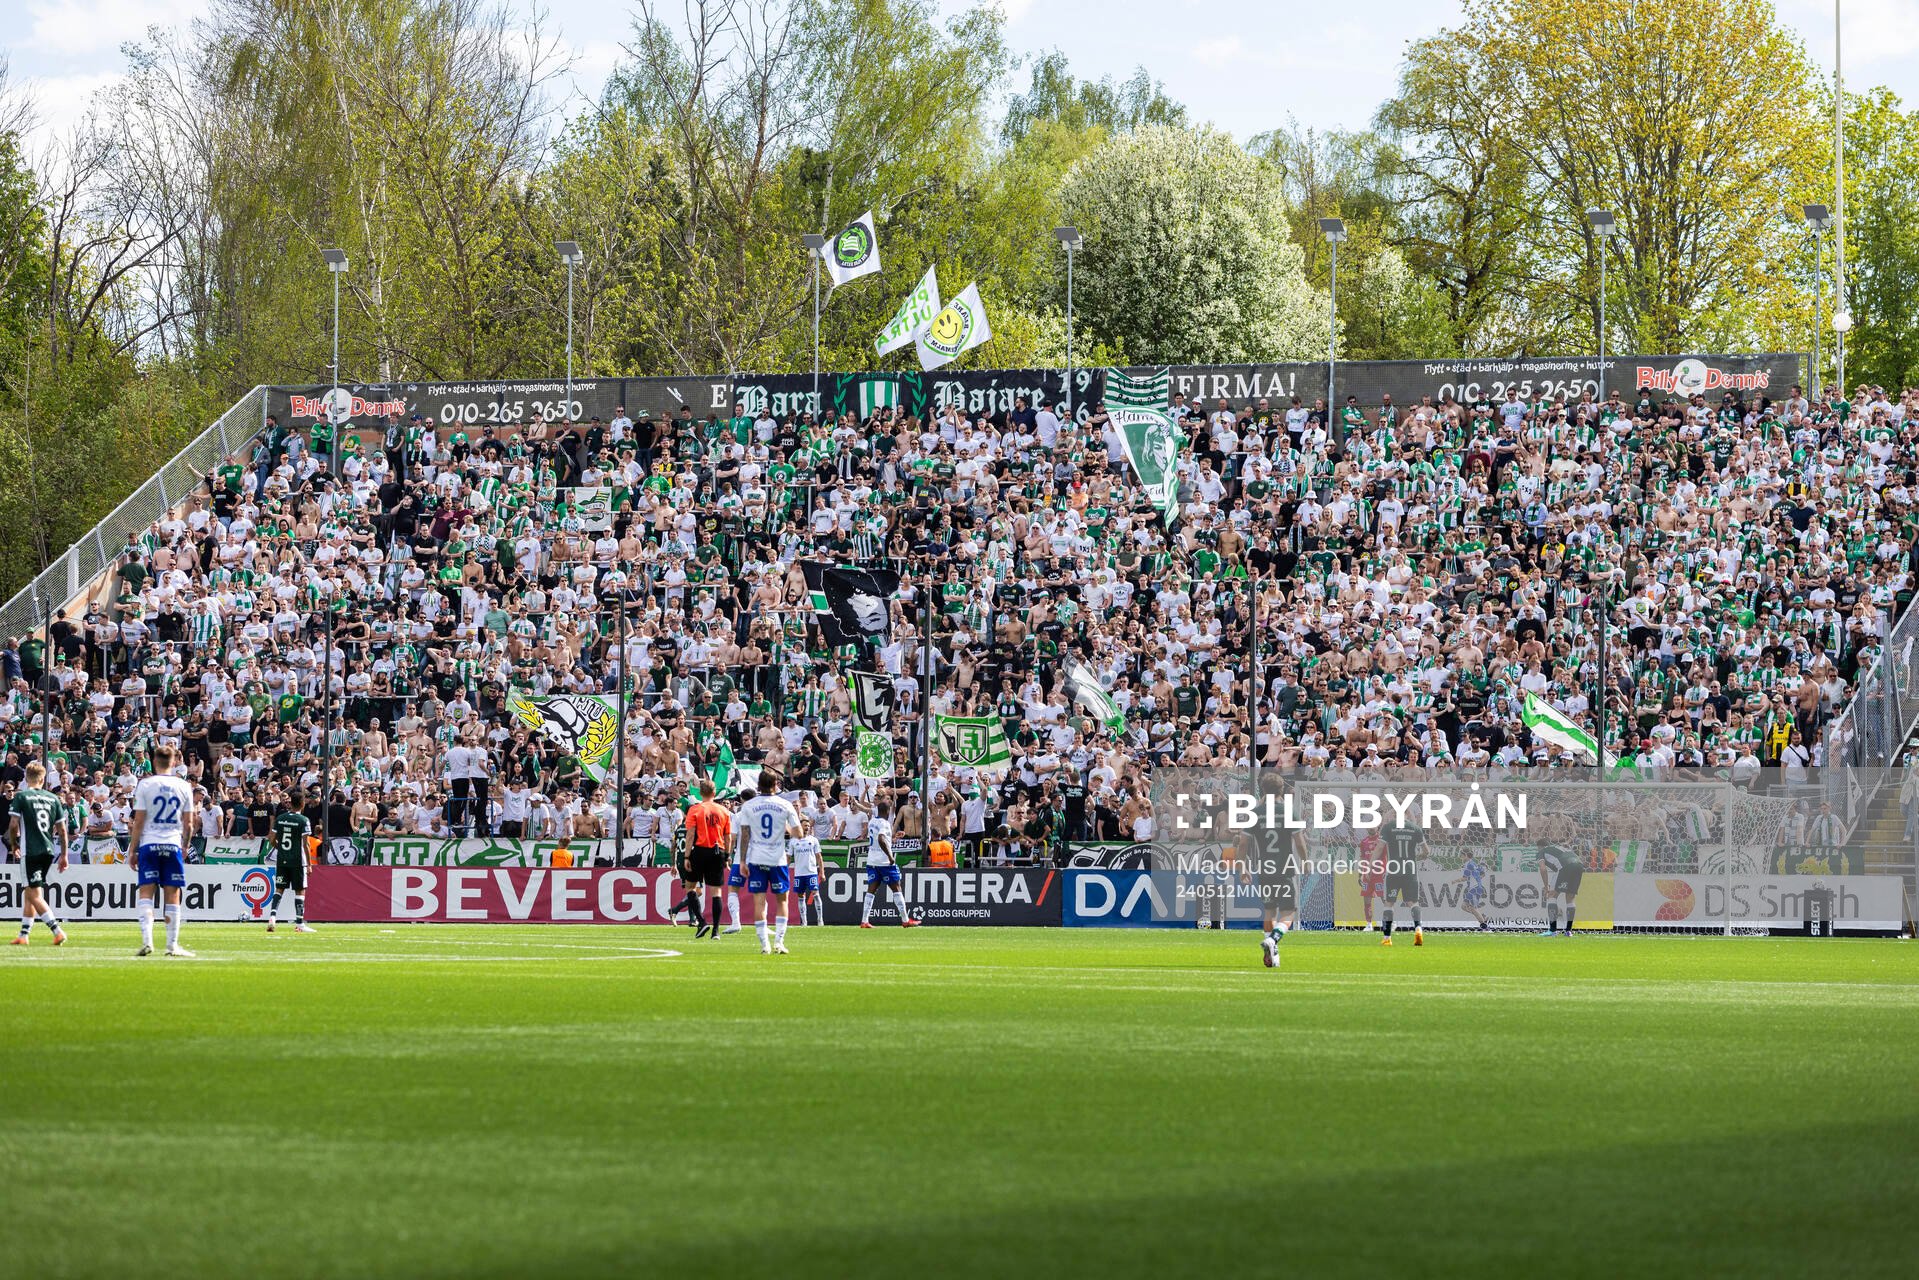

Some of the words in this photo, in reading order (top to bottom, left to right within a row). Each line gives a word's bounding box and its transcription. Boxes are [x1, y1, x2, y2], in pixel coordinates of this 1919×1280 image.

[1424, 363, 1445, 375] Flytt
[1451, 362, 1472, 373] städ
[1478, 361, 1514, 373] bärhjälp
[1520, 360, 1579, 373] magasinering
[428, 386, 447, 396] Flytt
[452, 385, 470, 394] städ
[476, 383, 507, 394] bärhjälp
[513, 382, 565, 394] magasinering
[571, 382, 597, 391] humor
[1636, 366, 1679, 394] Billy
[1704, 367, 1770, 391] Dennis
[351, 396, 406, 418] Dennis
[440, 400, 524, 424] 010-265
[152, 795, 181, 824] 22
[761, 813, 773, 839] 9
[281, 832, 293, 850] 5
[1265, 829, 1280, 853] 2
[232, 884, 264, 893] Thermia
[391, 869, 706, 920] BEVEGO
[828, 872, 1032, 904] OPIMERA
[882, 909, 898, 918] DEL
[927, 908, 951, 918] SGDS
[952, 908, 991, 918] GRUPPEN
[1811, 901, 1820, 936] SELECT
